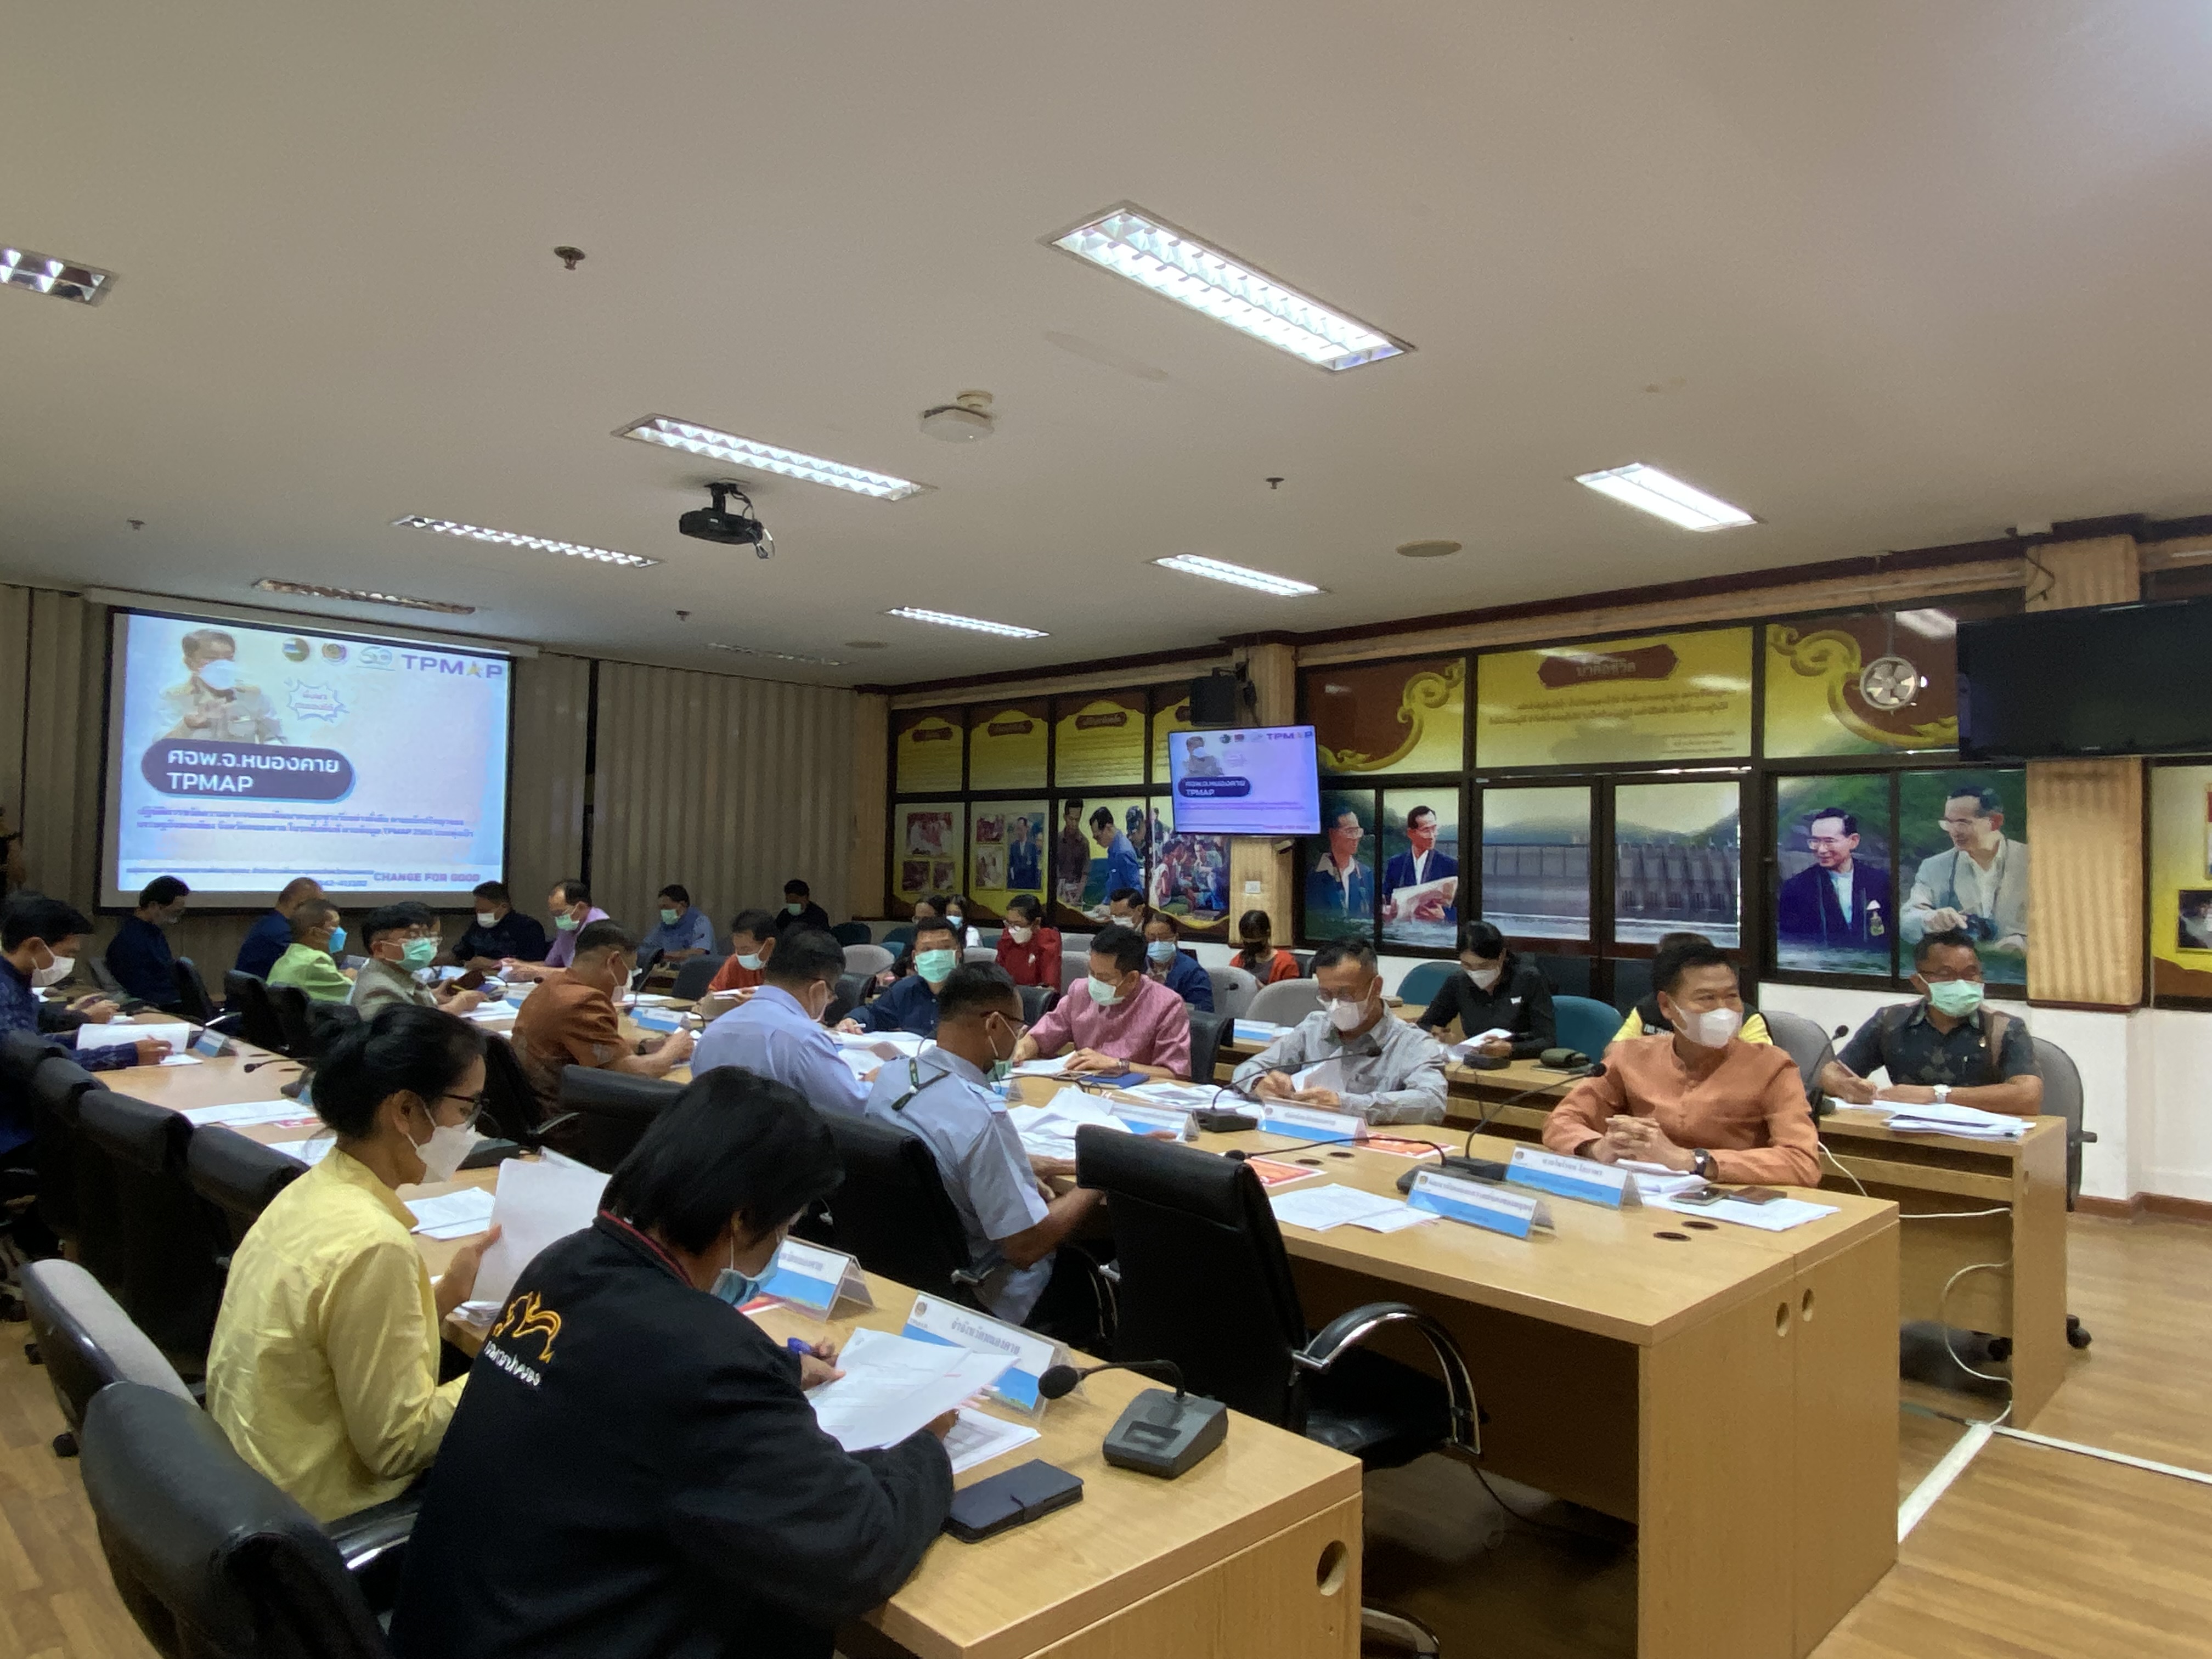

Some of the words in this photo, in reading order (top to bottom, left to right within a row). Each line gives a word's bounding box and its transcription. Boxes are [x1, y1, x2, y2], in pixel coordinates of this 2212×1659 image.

[167, 772, 254, 792] TPMAP
[375, 873, 421, 881] CHANGE
[425, 873, 447, 882] FOR
